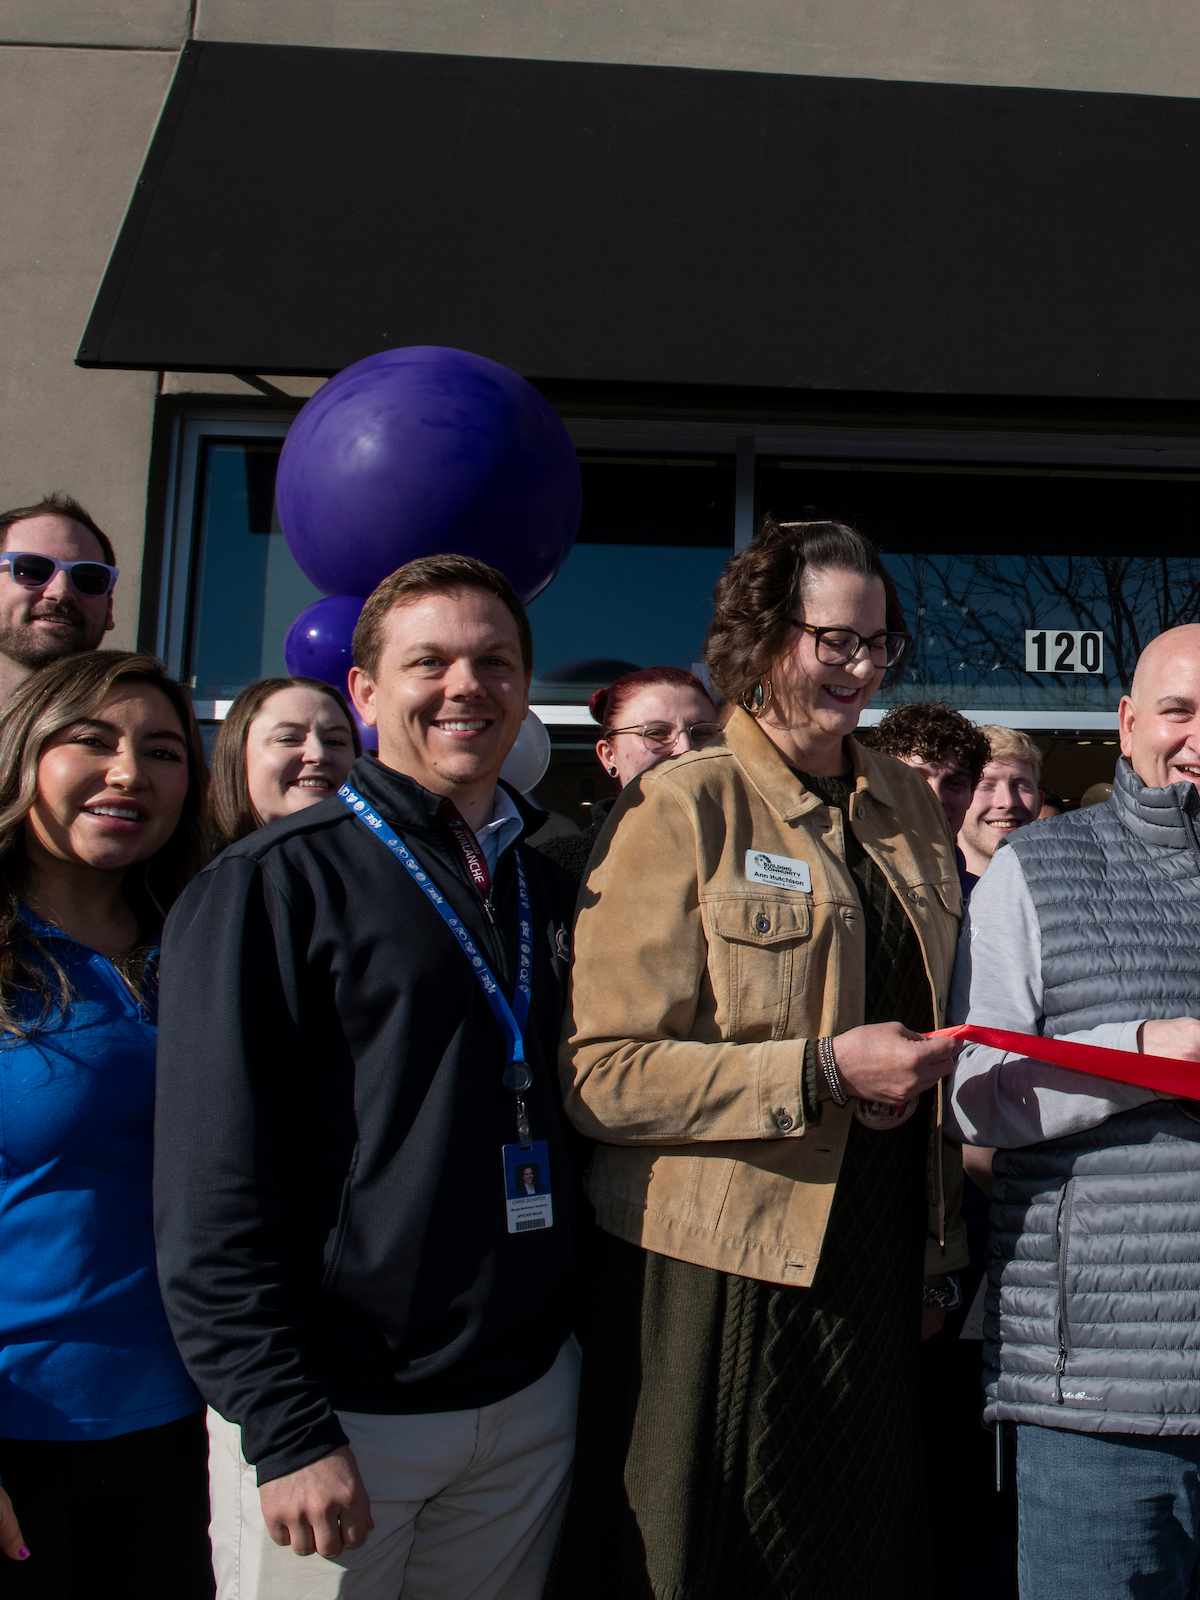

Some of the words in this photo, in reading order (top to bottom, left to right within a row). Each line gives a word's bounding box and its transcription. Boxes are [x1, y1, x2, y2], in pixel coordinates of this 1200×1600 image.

[1032, 632, 1100, 672] 120
[364, 813, 383, 829] KSE
[452, 830, 485, 884] AVALANCHE
[763, 862, 792, 872] BUILDING
[763, 866, 801, 878] COMMUNITY
[770, 874, 804, 886] Hutchison
[426, 887, 444, 904] KSE
[519, 920, 530, 939] KSE
[480, 973, 497, 994] KSE
